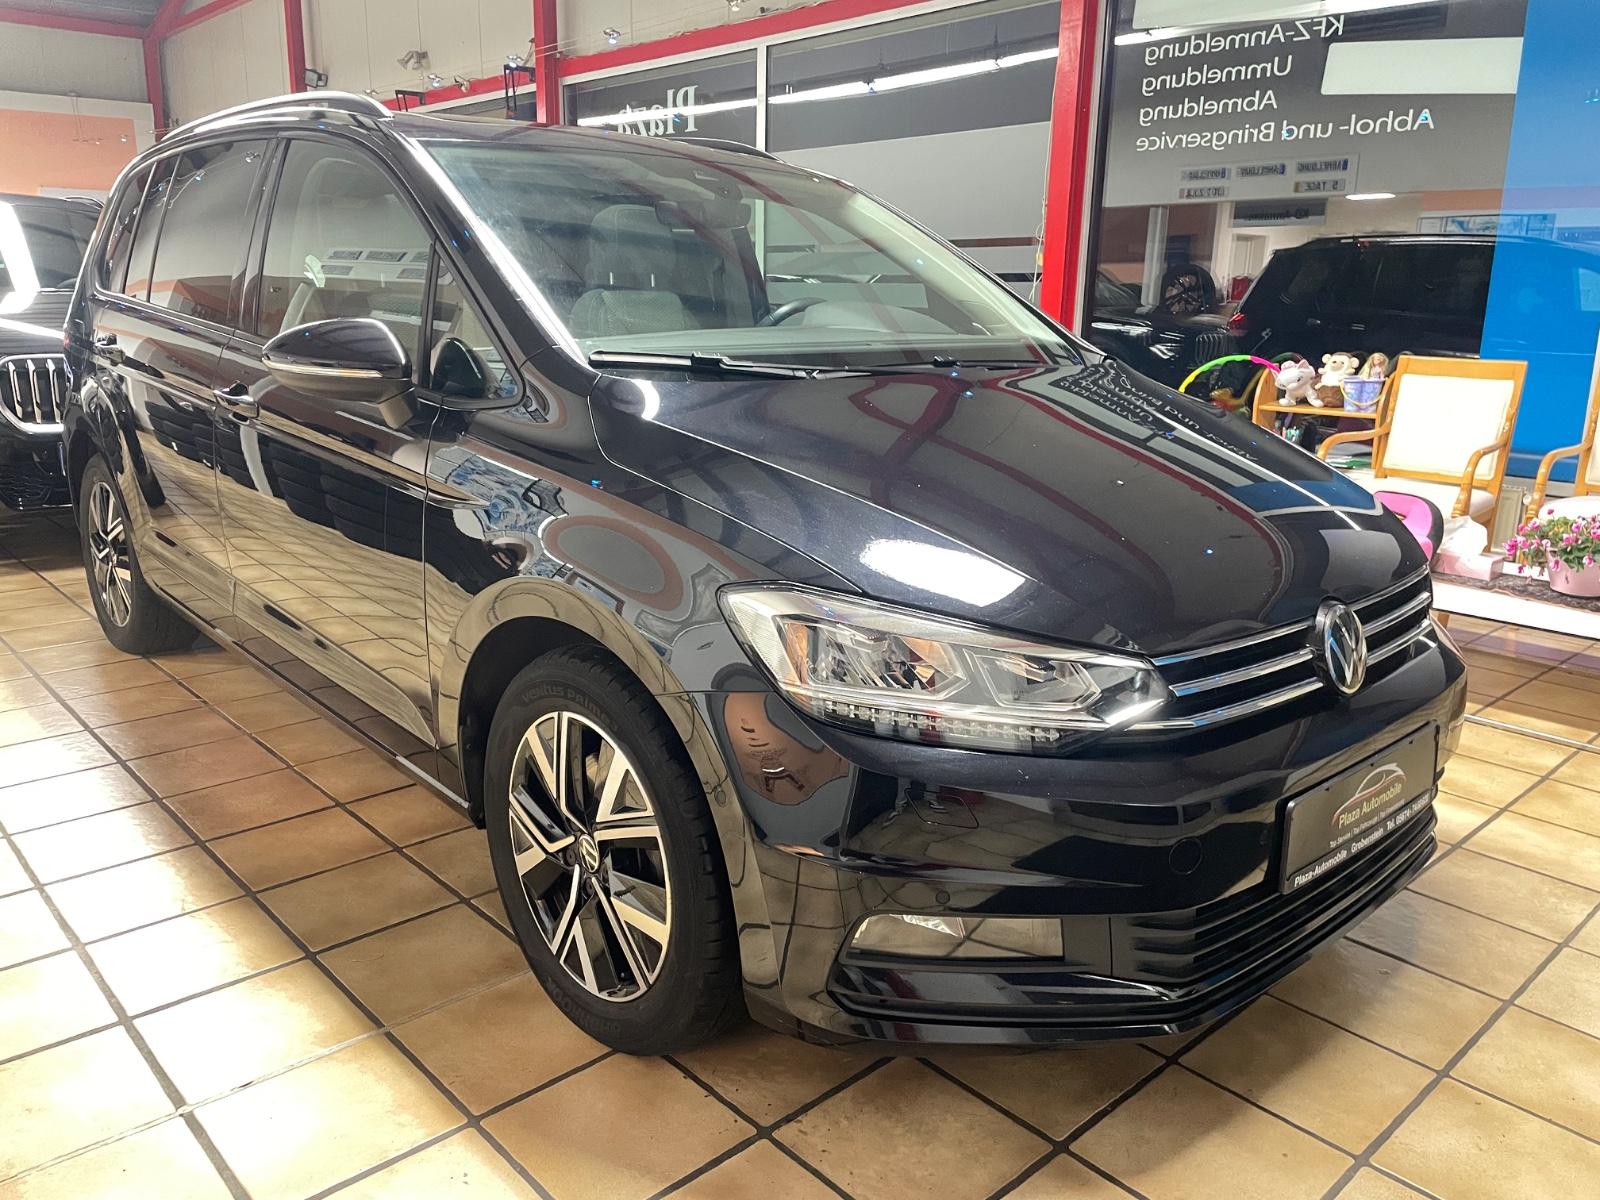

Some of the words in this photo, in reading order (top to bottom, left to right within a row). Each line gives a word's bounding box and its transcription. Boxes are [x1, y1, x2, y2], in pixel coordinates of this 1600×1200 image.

[1339, 808, 1360, 829] Plaza
[1361, 783, 1402, 815] Automobile
[1294, 849, 1347, 887] Plaza-Automobile
